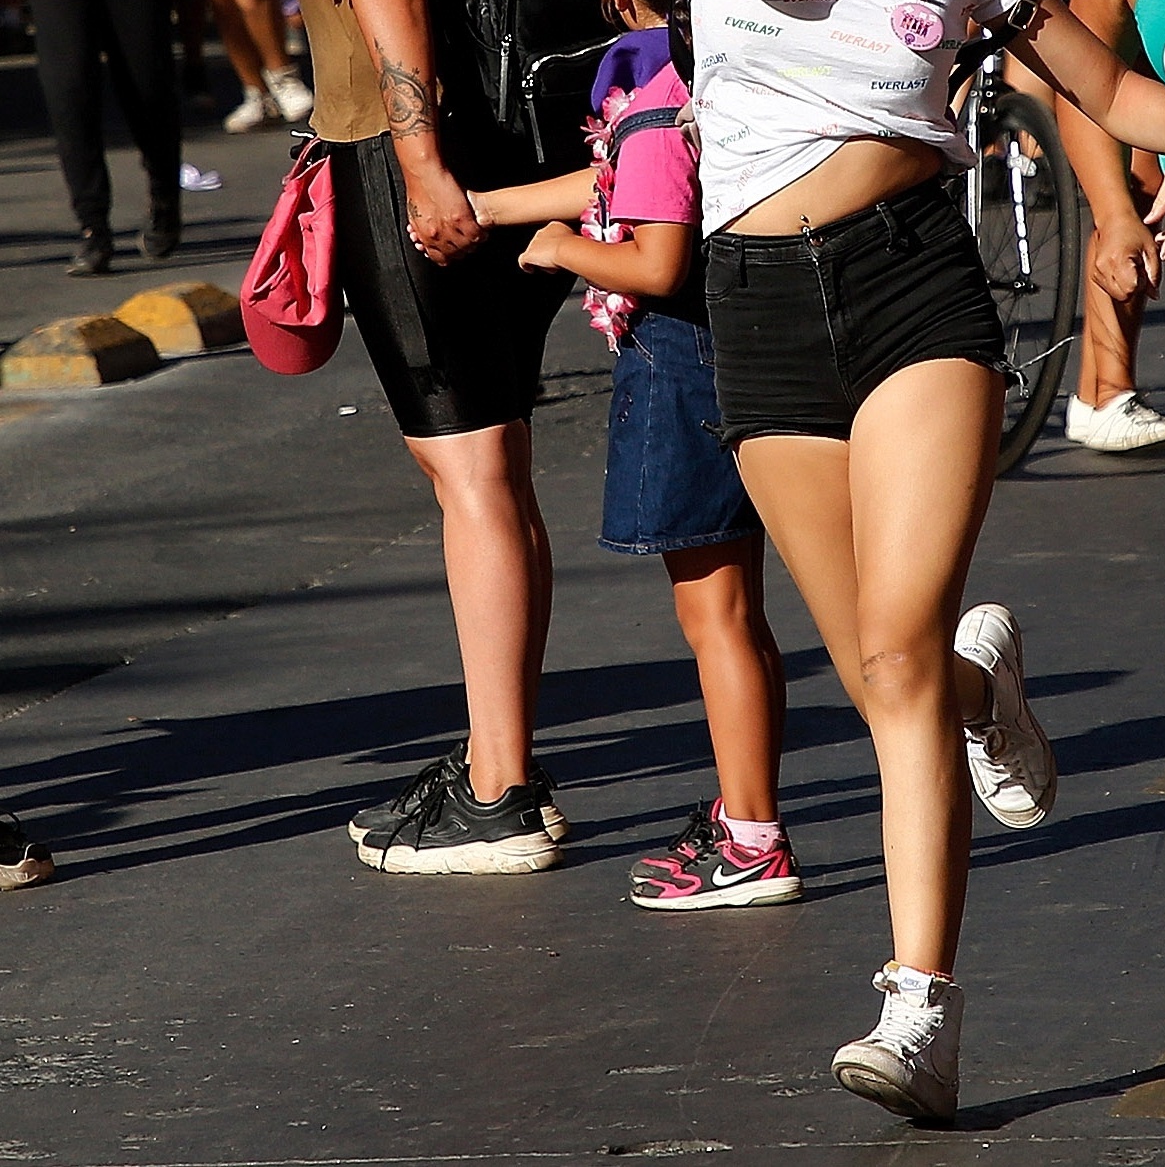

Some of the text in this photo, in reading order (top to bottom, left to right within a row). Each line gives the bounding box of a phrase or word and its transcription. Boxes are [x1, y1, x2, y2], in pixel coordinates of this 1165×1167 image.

[724, 16, 784, 37] EVERLAST
[829, 30, 893, 53] EVERLAST
[871, 77, 928, 90] EVERLAST
